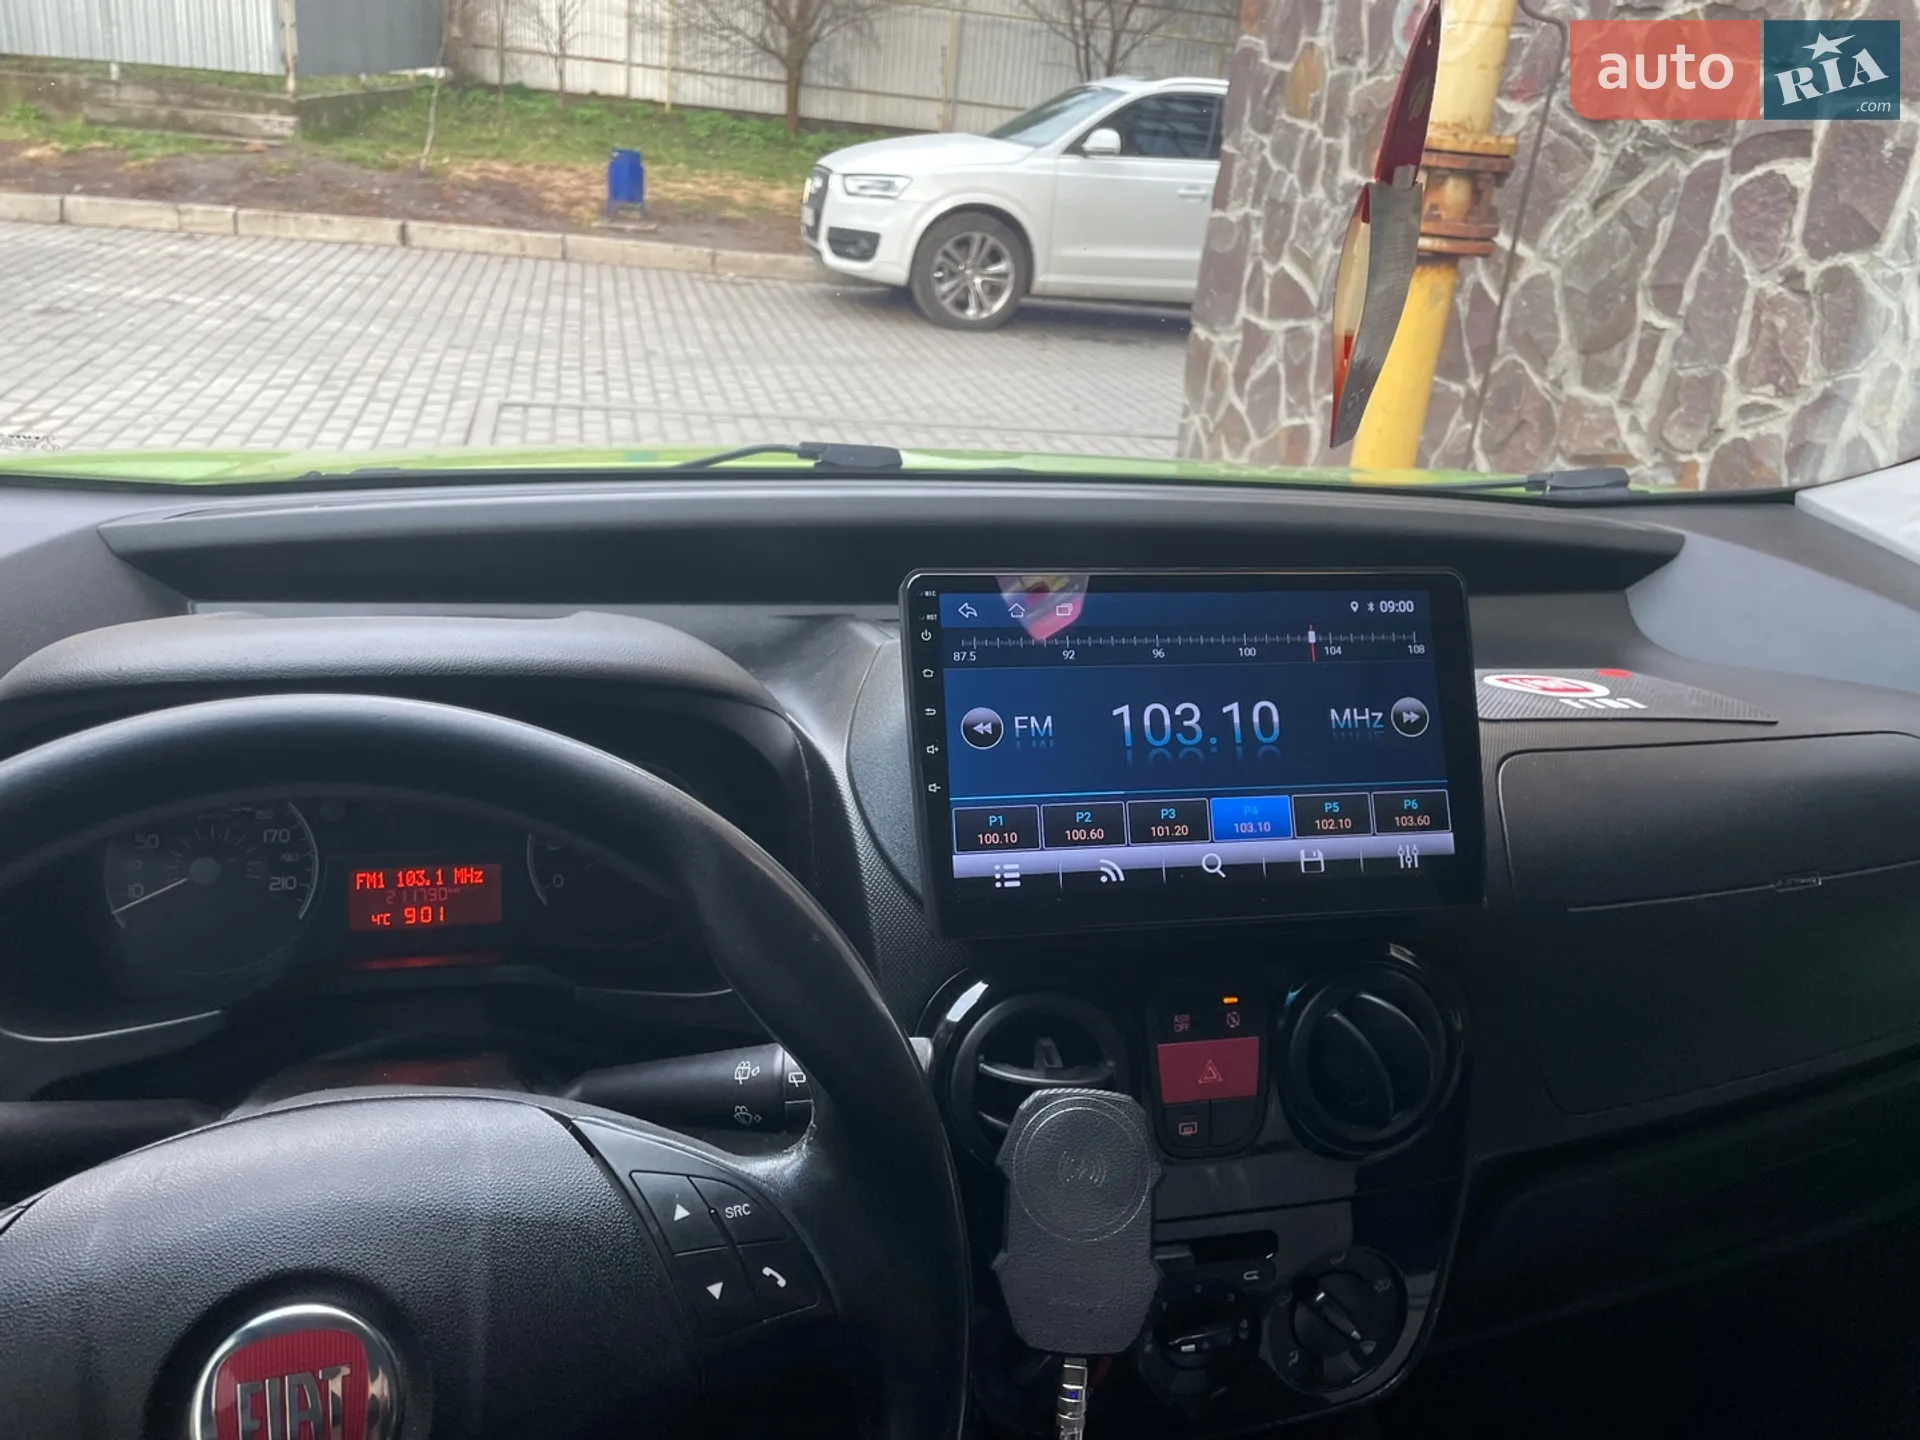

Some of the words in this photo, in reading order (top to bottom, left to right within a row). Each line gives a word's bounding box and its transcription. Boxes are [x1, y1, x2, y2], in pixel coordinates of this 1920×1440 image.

[1379, 600, 1415, 613] 09:00
[953, 651, 977, 662] 87.5
[1062, 649, 1076, 660] 92
[1152, 648, 1166, 659] 96
[1238, 647, 1257, 657] 100
[1324, 645, 1342, 656] 104
[1407, 644, 1426, 654] 108
[1014, 715, 1054, 738] FM
[1112, 700, 1281, 747] 103.10
[1330, 707, 1384, 729] MHz
[1243, 805, 1259, 816] P4
[1324, 801, 1340, 813] P5
[1403, 798, 1419, 810] P6
[1076, 812, 1092, 823] P2
[1161, 808, 1176, 820] P3
[988, 815, 1004, 827] P1
[1233, 821, 1271, 834] 103.10
[1315, 818, 1352, 830] 102.10
[1394, 815, 1431, 827] 103.60
[264, 829, 290, 843] 170
[1065, 828, 1104, 841] 100.60
[1150, 824, 1189, 837] 101.20
[134, 834, 159, 849] 50
[977, 831, 1018, 845] 100.10
[269, 876, 297, 891] 210
[355, 871, 386, 890] FM1
[397, 868, 444, 888] 103.1
[454, 867, 484, 884] MHz
[725, 1203, 751, 1220] SRC
[237, 1364, 351, 1440] FIAT
